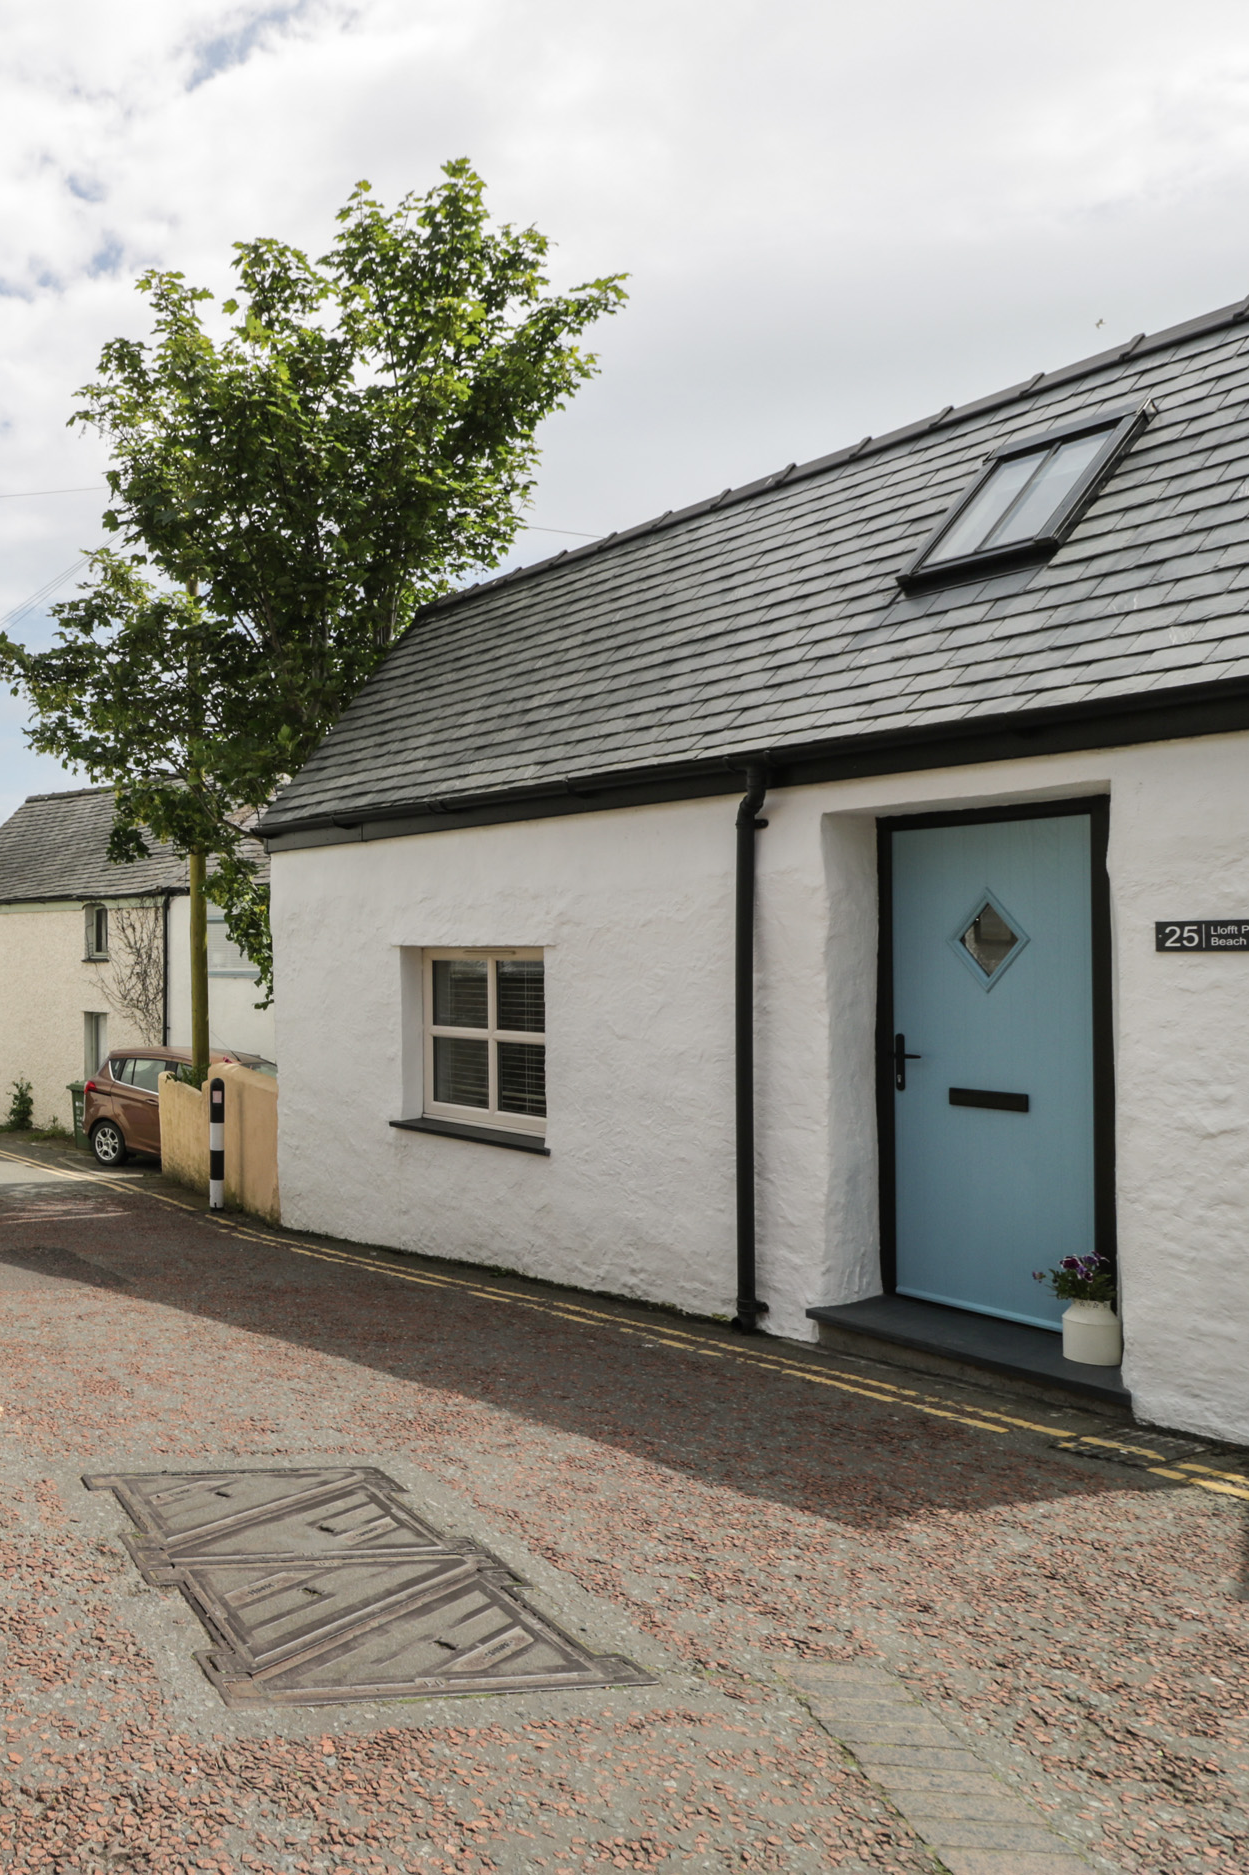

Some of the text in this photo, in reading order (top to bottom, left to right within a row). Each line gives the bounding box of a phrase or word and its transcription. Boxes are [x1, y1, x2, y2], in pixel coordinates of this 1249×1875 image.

[1210, 925, 1239, 935] Llofft
[1164, 926, 1199, 947] 25
[1210, 936, 1247, 946] Beach
